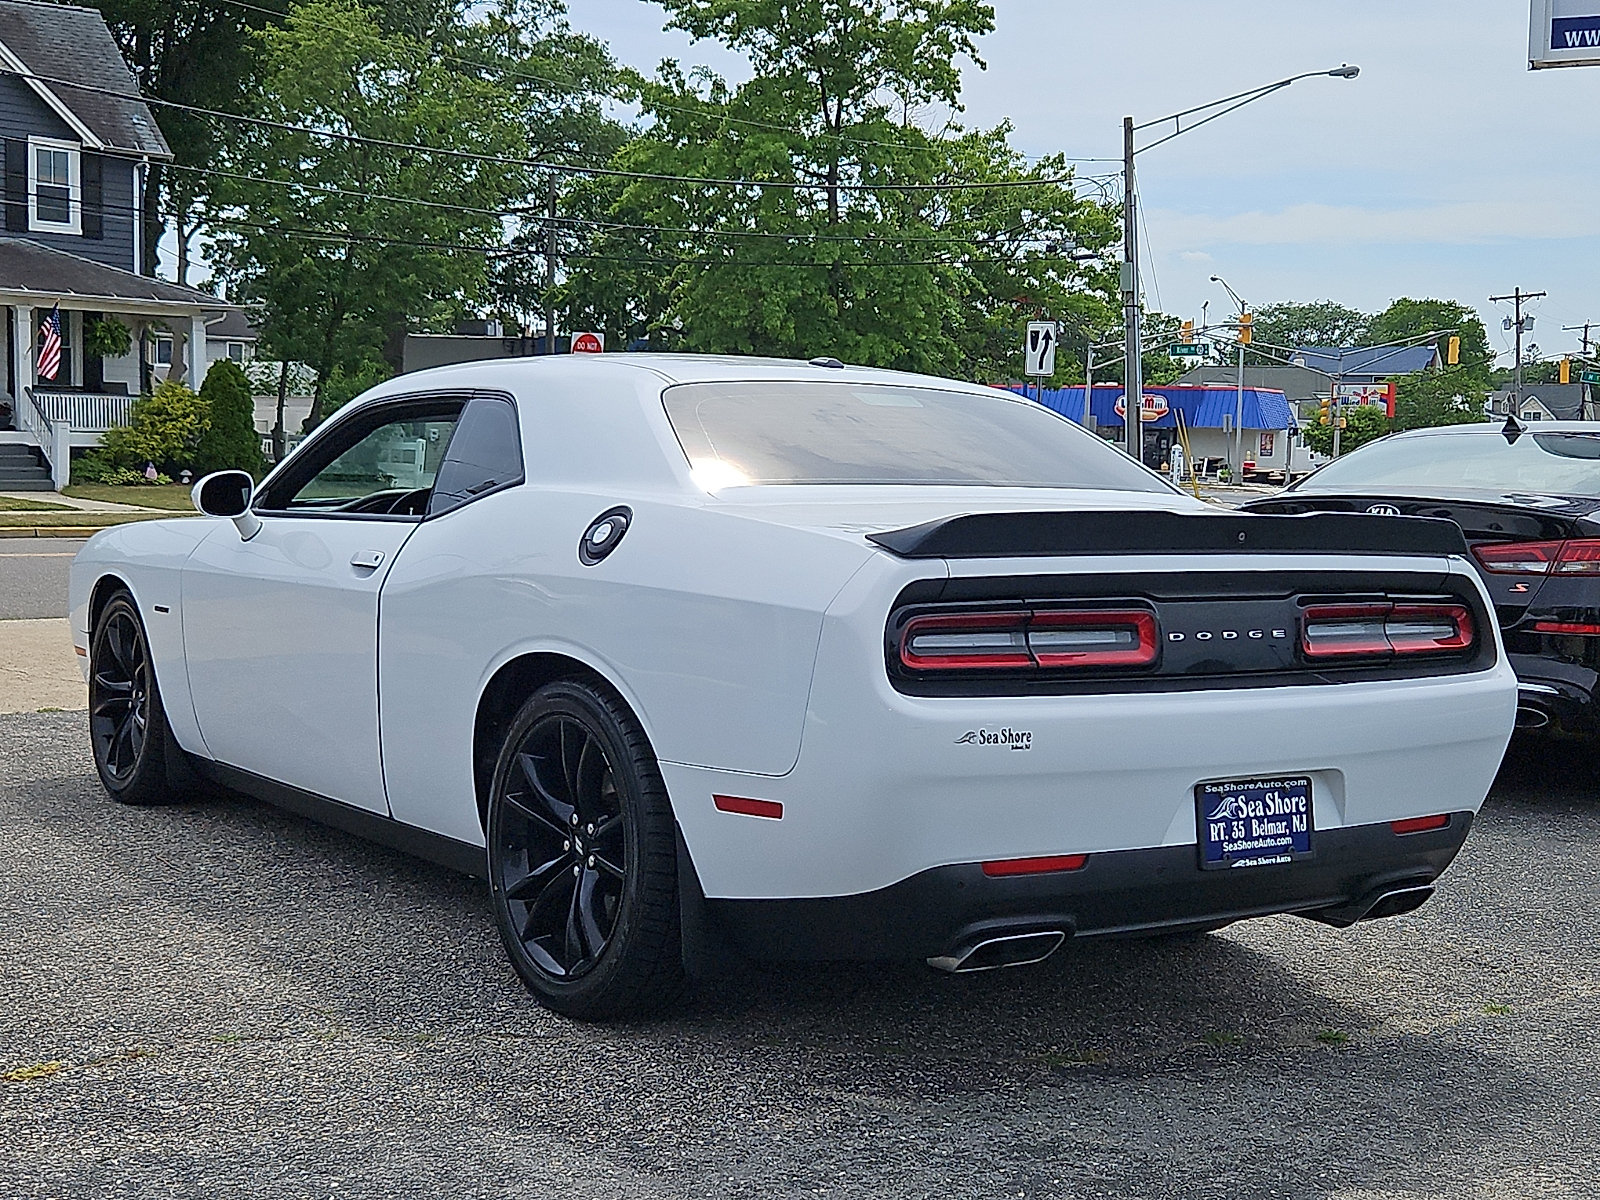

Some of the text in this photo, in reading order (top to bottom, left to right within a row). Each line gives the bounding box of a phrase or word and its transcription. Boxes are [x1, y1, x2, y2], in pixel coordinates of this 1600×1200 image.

[577, 341, 598, 351] DO NOT
[1371, 507, 1393, 516] KIA
[1168, 629, 1286, 641] DODGE
[979, 727, 1032, 745] Sea Shore
[1204, 779, 1308, 793] SeaShoreAuto.com
[1237, 791, 1307, 819] Sea Shore
[1209, 814, 1307, 842] RT. 35 Belmar, NJ
[1222, 836, 1293, 852] SeaShoreAuto.com
[1257, 856, 1276, 866] Shore
